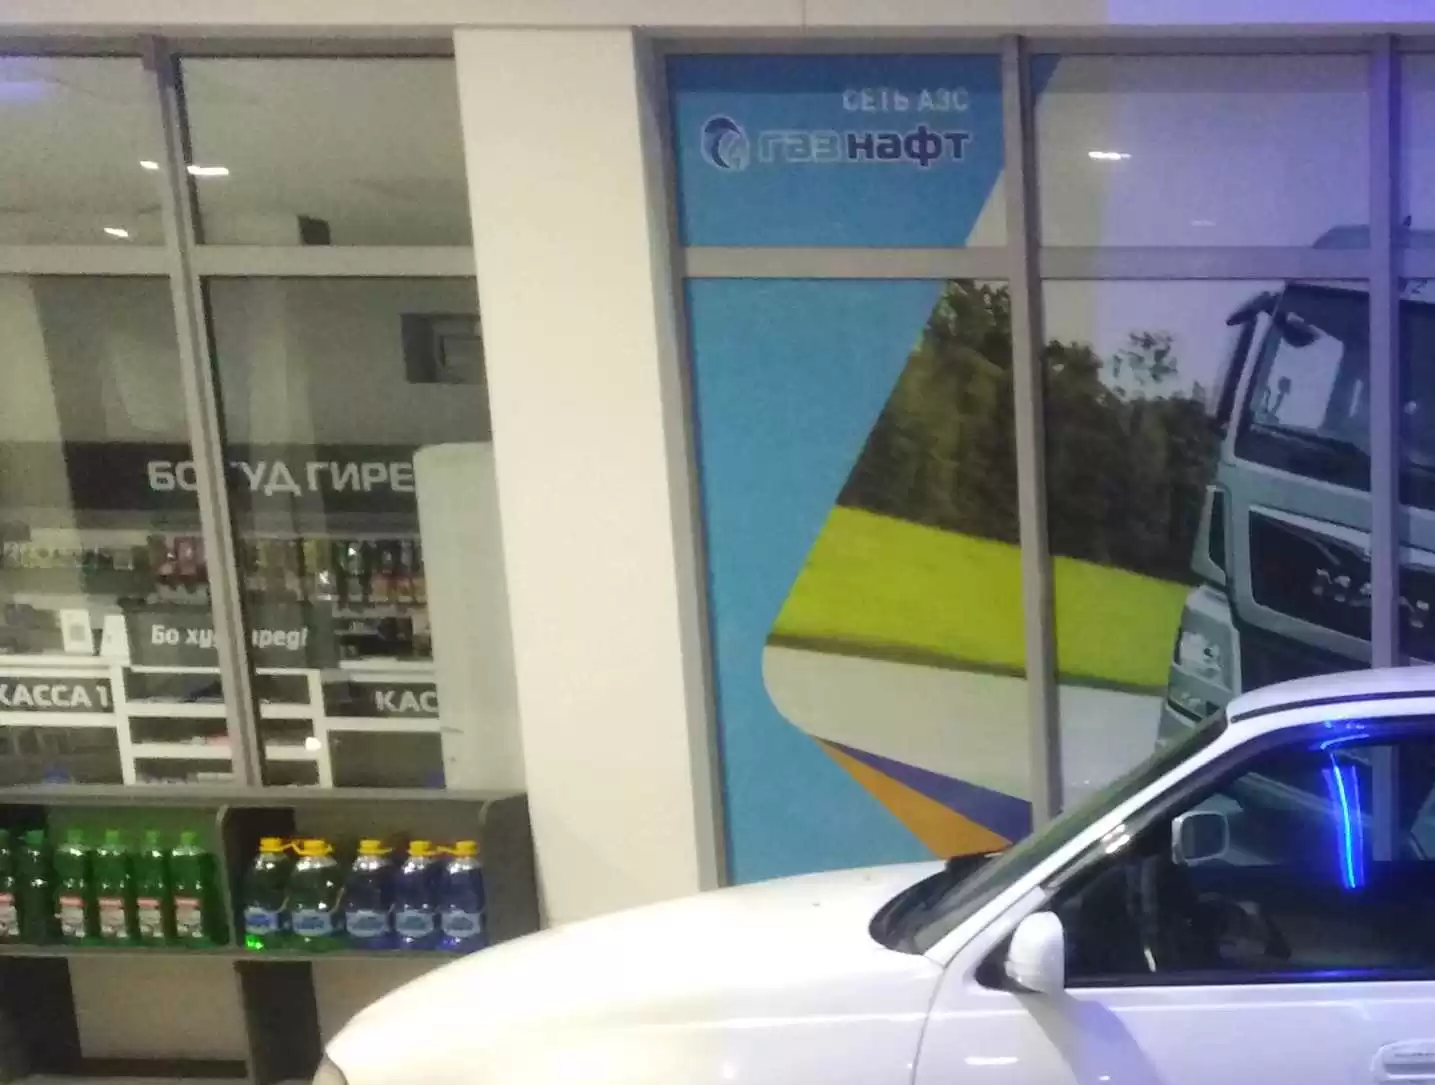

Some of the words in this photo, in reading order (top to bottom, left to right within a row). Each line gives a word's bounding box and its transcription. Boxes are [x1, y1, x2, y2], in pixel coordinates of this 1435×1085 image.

[841, 87, 909, 111] СЕТЬ
[917, 87, 969, 111] АЗС
[147, 460, 199, 491] БО
[305, 461, 415, 492] ГИРЕ
[151, 624, 179, 645] Бо
[95, 685, 109, 708] 1
[374, 690, 438, 713] КАС
